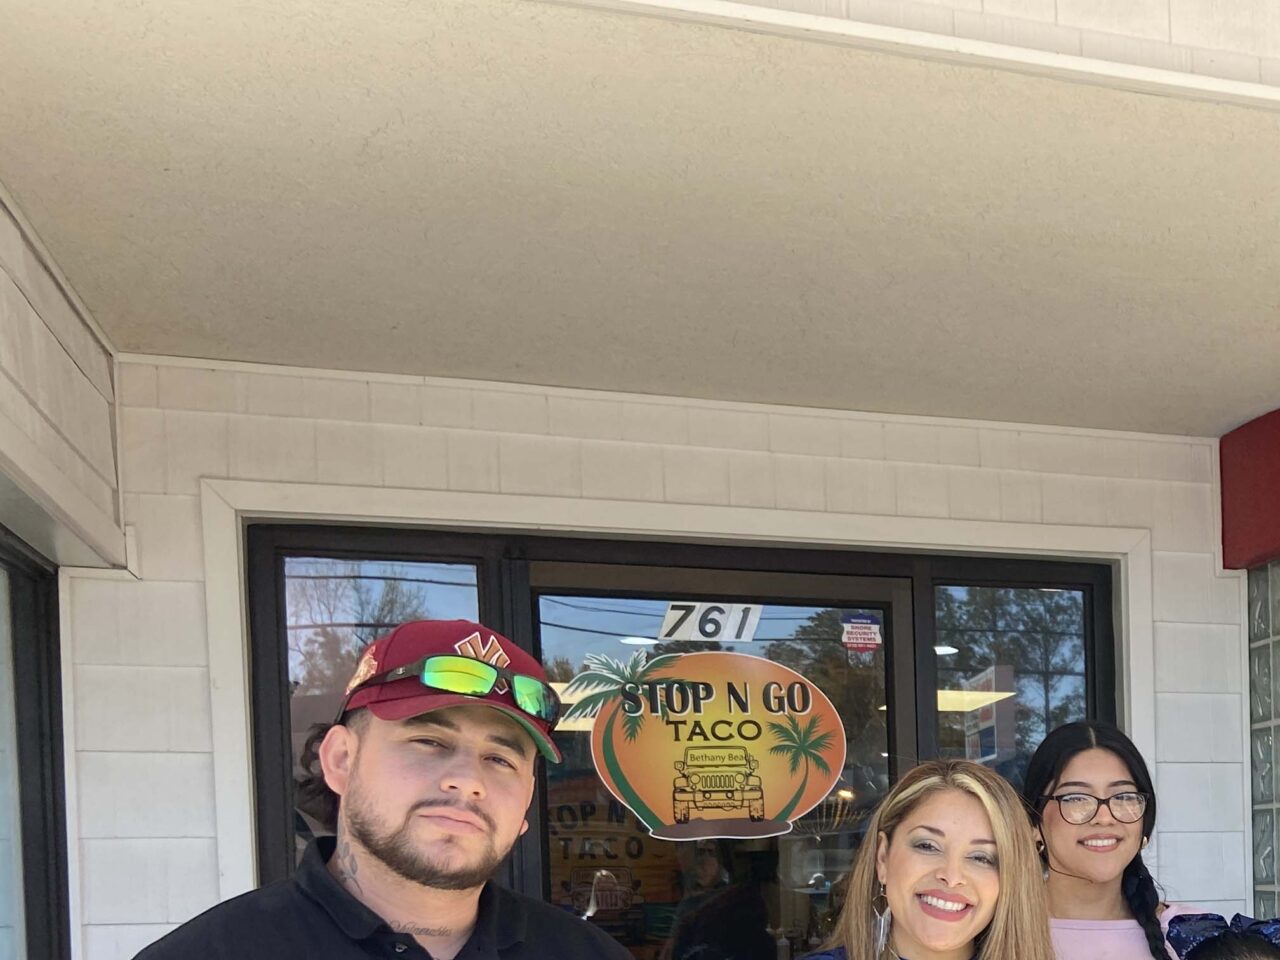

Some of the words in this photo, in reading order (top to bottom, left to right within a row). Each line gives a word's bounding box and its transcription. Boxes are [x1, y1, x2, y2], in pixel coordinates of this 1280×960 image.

[663, 604, 752, 640] 761
[621, 681, 714, 716] STOP
[727, 681, 751, 715] N
[762, 681, 812, 715] GO
[665, 719, 762, 742] TACO
[690, 753, 726, 763] Bethany
